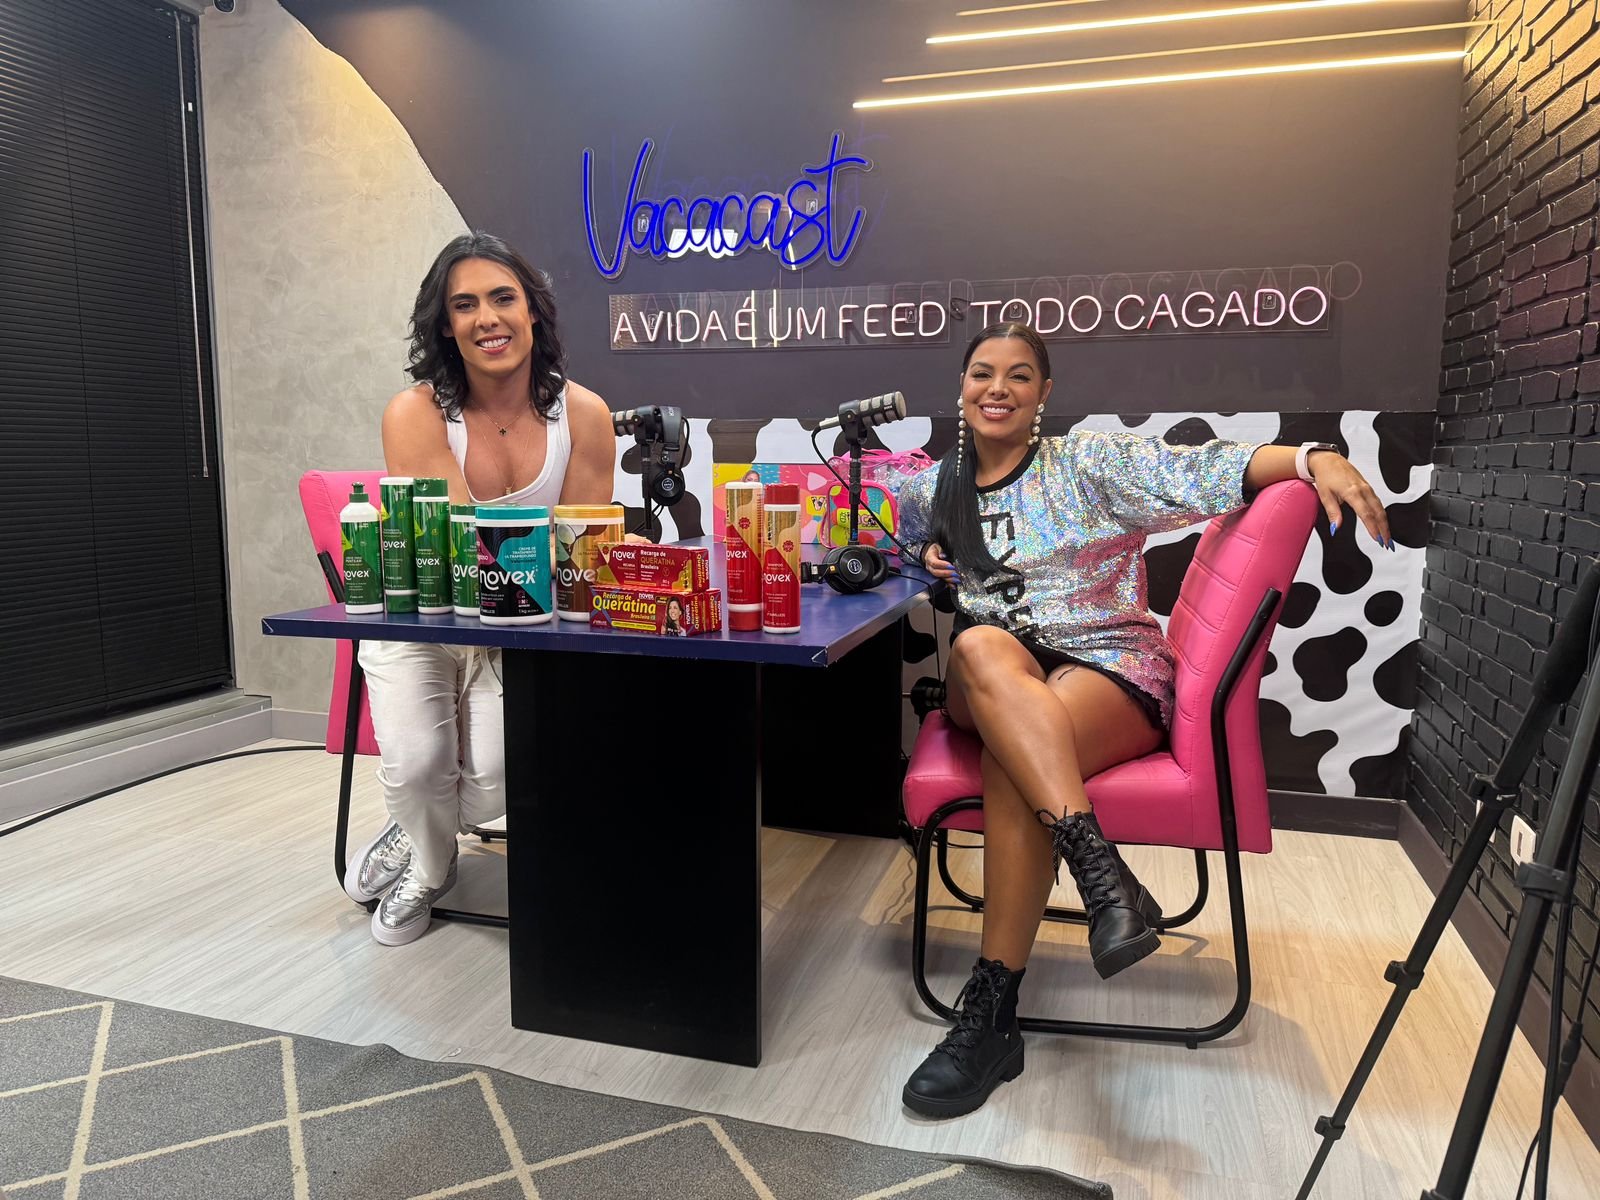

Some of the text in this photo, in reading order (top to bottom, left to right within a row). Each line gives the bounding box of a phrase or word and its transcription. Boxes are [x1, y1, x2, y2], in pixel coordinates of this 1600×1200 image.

[583, 134, 868, 273] Vacacast
[612, 286, 1327, 343] A VIDA É UM FEED TODO CAGADO
[383, 540, 406, 551] ovex
[612, 550, 636, 561] novex
[640, 549, 659, 558] Recarga
[640, 556, 676, 566] QUERATINA
[726, 549, 748, 561] ovex
[452, 563, 479, 582] ove
[480, 569, 536, 591] novex
[556, 567, 597, 587] nove
[602, 591, 632, 601] Recarga de
[592, 594, 656, 615] Queratina
